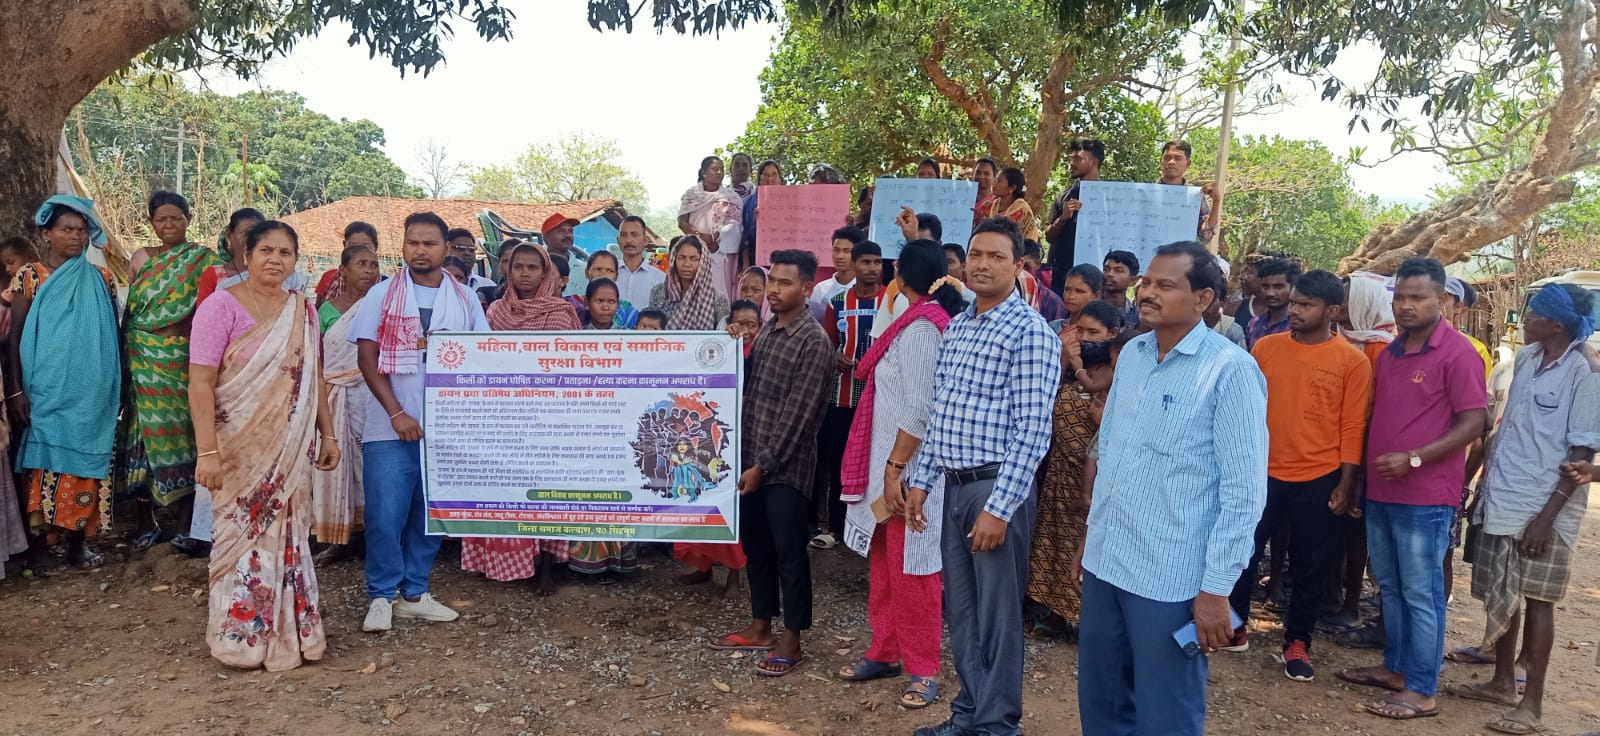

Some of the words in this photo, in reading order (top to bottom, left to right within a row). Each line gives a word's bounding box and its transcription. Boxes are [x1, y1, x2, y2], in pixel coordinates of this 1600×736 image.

[554, 337, 599, 352] विकास
[603, 338, 623, 354] एवं
[537, 357, 576, 373] सुरक्षा
[580, 354, 623, 368] विभाग
[456, 375, 475, 385] किसी
[477, 375, 487, 385] को
[510, 375, 531, 385] घोषित
[534, 377, 556, 385] करना
[671, 377, 697, 385] अपराध
[562, 390, 582, 398] 2001
[517, 522, 537, 533] जिला
